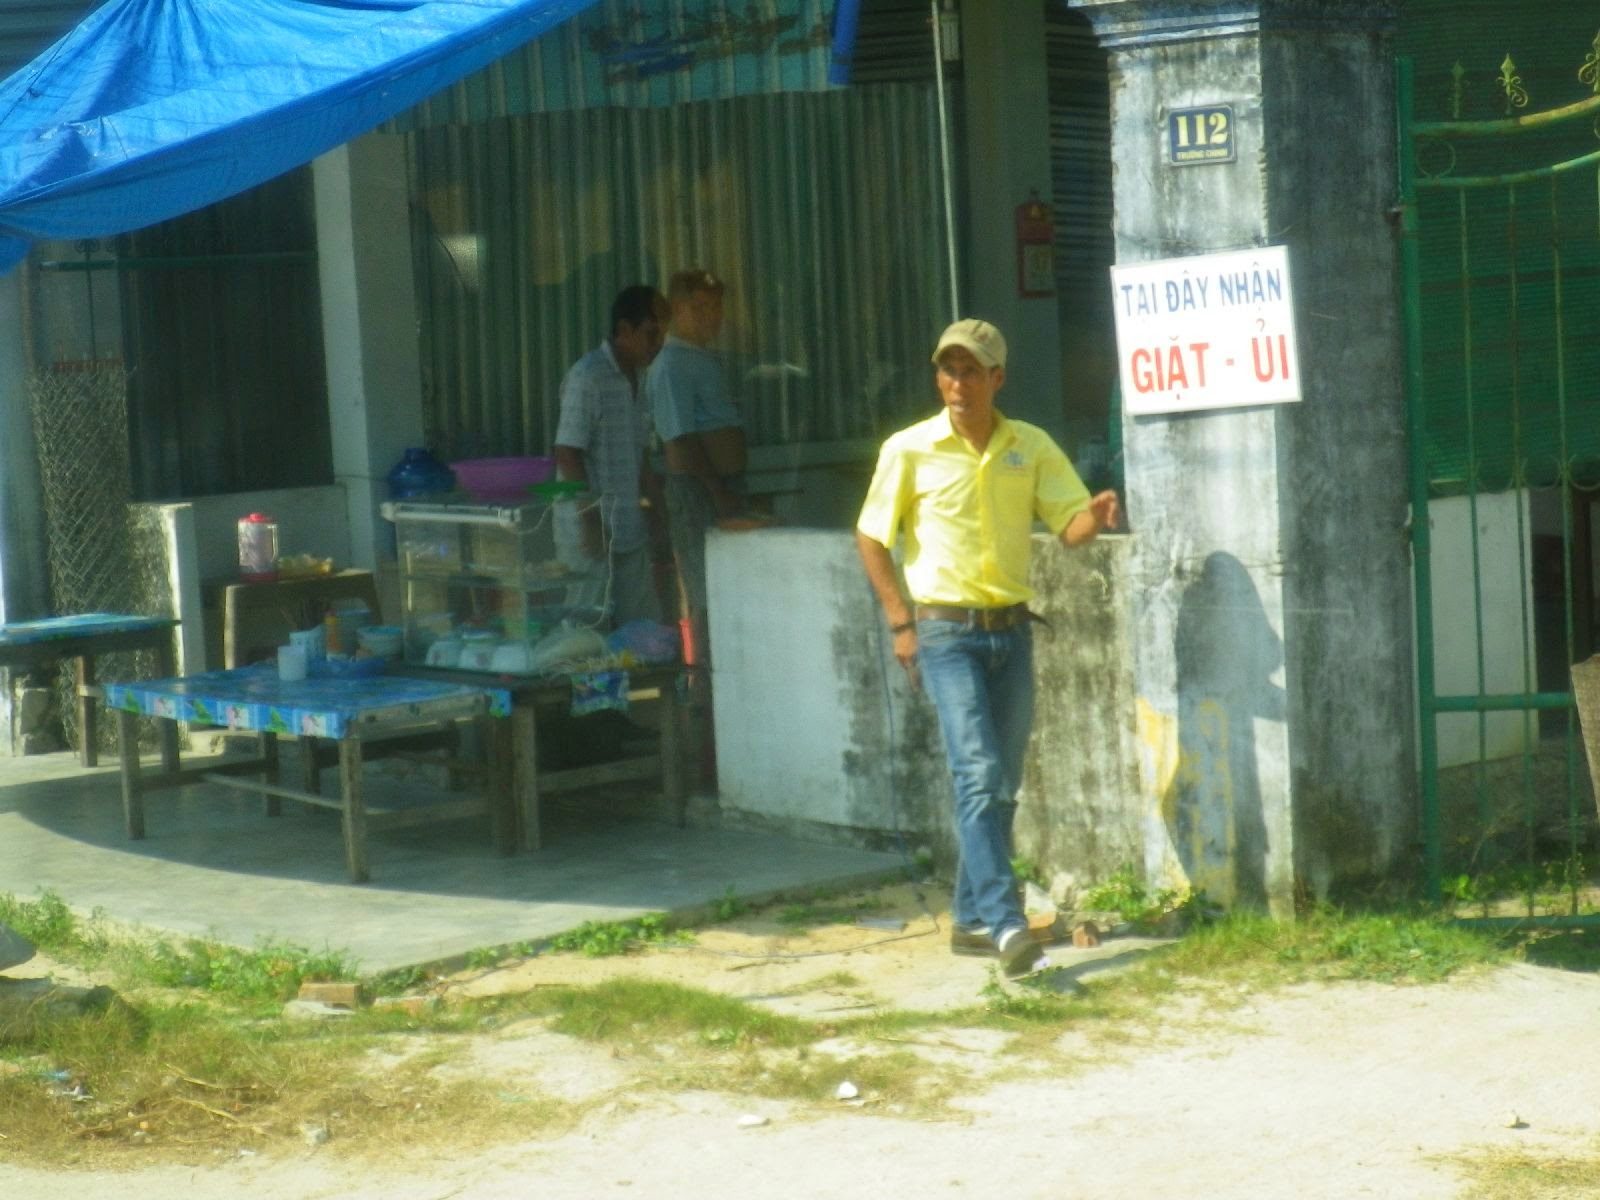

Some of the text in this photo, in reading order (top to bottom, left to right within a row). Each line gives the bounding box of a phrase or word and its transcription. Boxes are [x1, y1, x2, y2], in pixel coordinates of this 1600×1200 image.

[1176, 112, 1228, 147] 112
[1165, 269, 1209, 312] ĐÂY
[1131, 335, 1210, 400] GIẶT
[1251, 318, 1289, 383] ỦI
